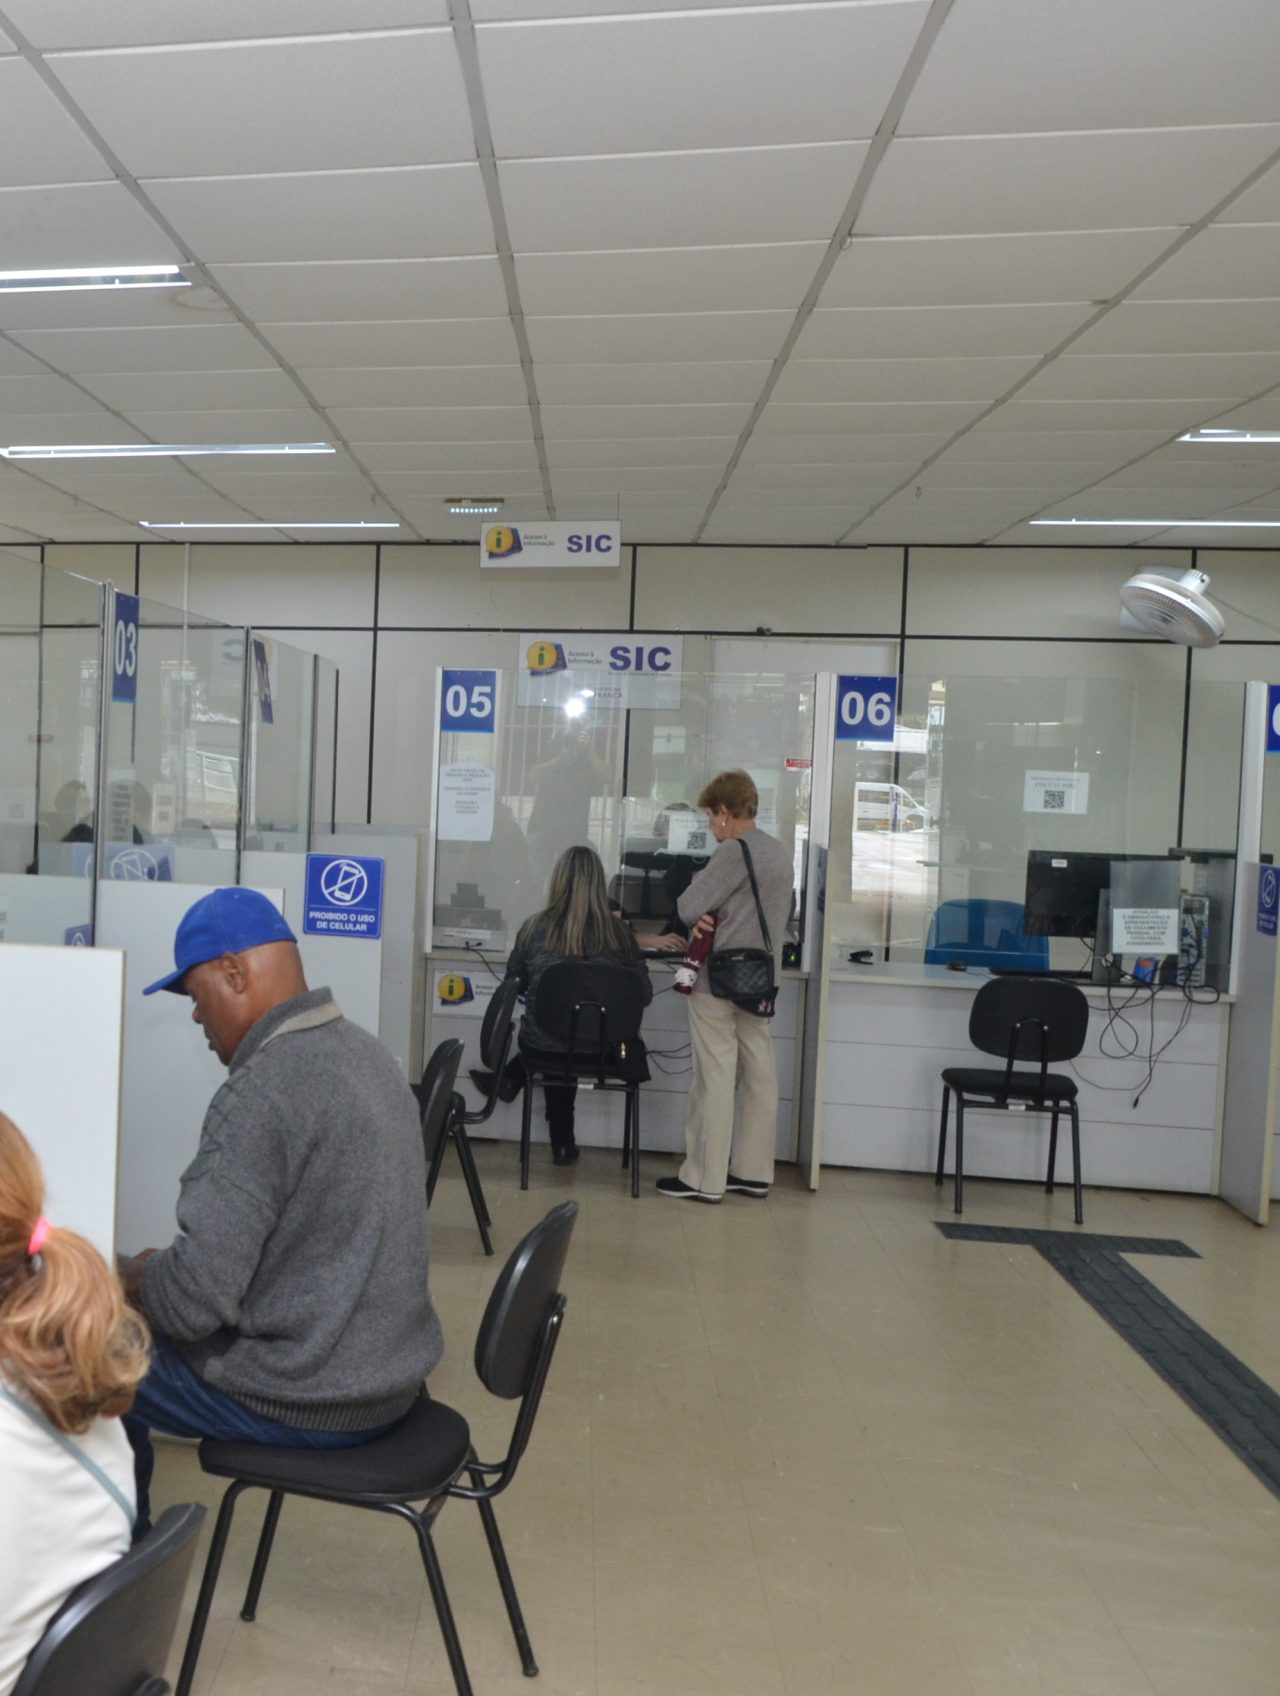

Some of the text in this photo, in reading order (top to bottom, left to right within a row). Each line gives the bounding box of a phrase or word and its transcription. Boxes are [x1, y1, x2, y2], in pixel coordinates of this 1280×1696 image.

[567, 534, 613, 553] SIC
[115, 619, 136, 677] 03
[608, 646, 673, 672] SIC
[445, 685, 492, 718] 05
[841, 691, 891, 727] 06
[309, 911, 376, 924] PROIBIDO O USO
[316, 921, 368, 932] DE CELULAR
